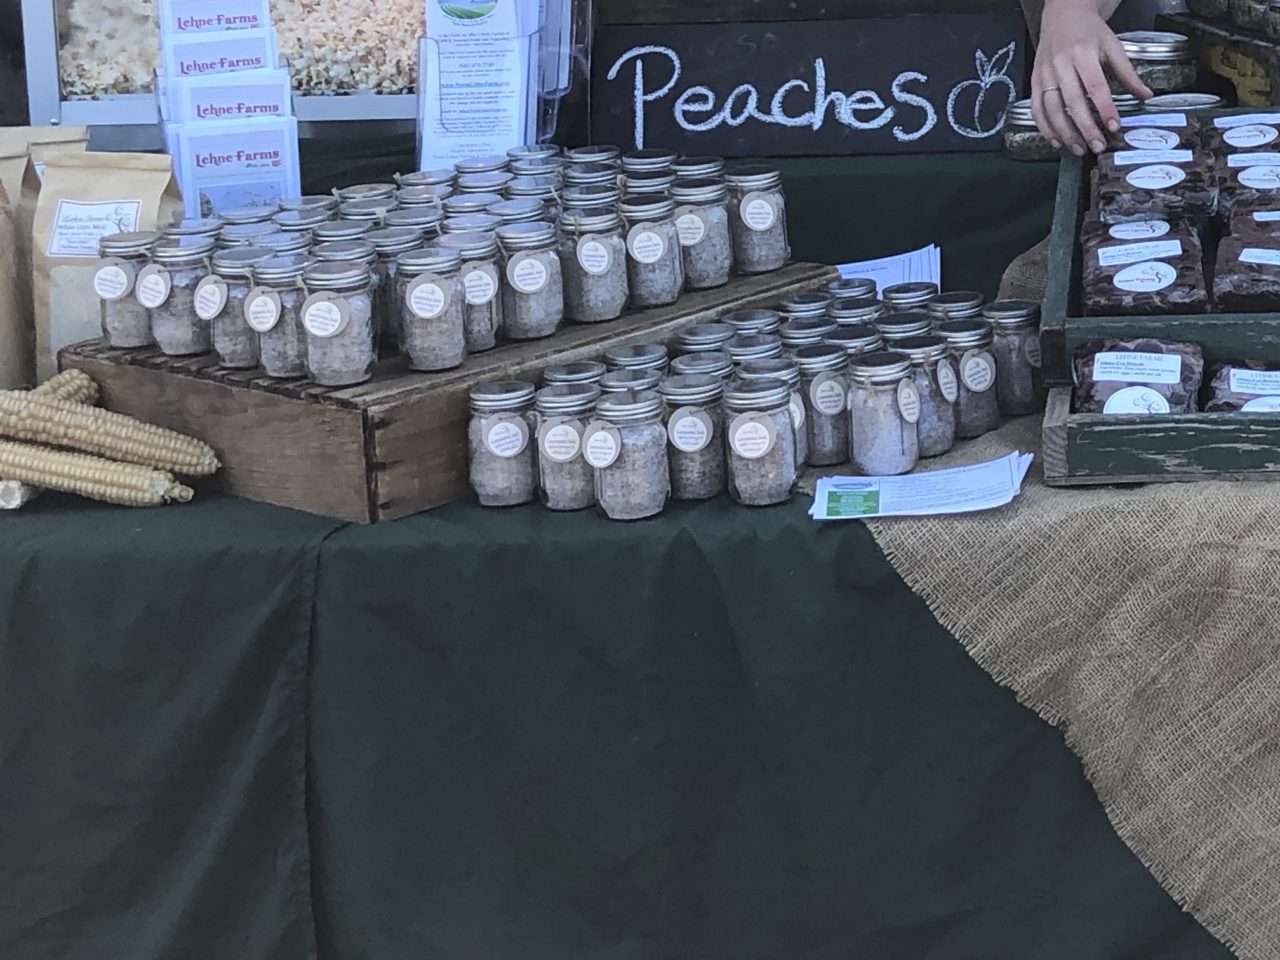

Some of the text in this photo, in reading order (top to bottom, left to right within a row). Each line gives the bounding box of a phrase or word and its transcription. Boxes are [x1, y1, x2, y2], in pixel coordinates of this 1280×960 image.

[177, 13, 259, 31] Lehne Farms
[180, 56, 262, 75] Lehne Farms
[196, 102, 280, 119] Lehne Farms
[196, 153, 233, 168] Lehne
[233, 149, 280, 162] Farms
